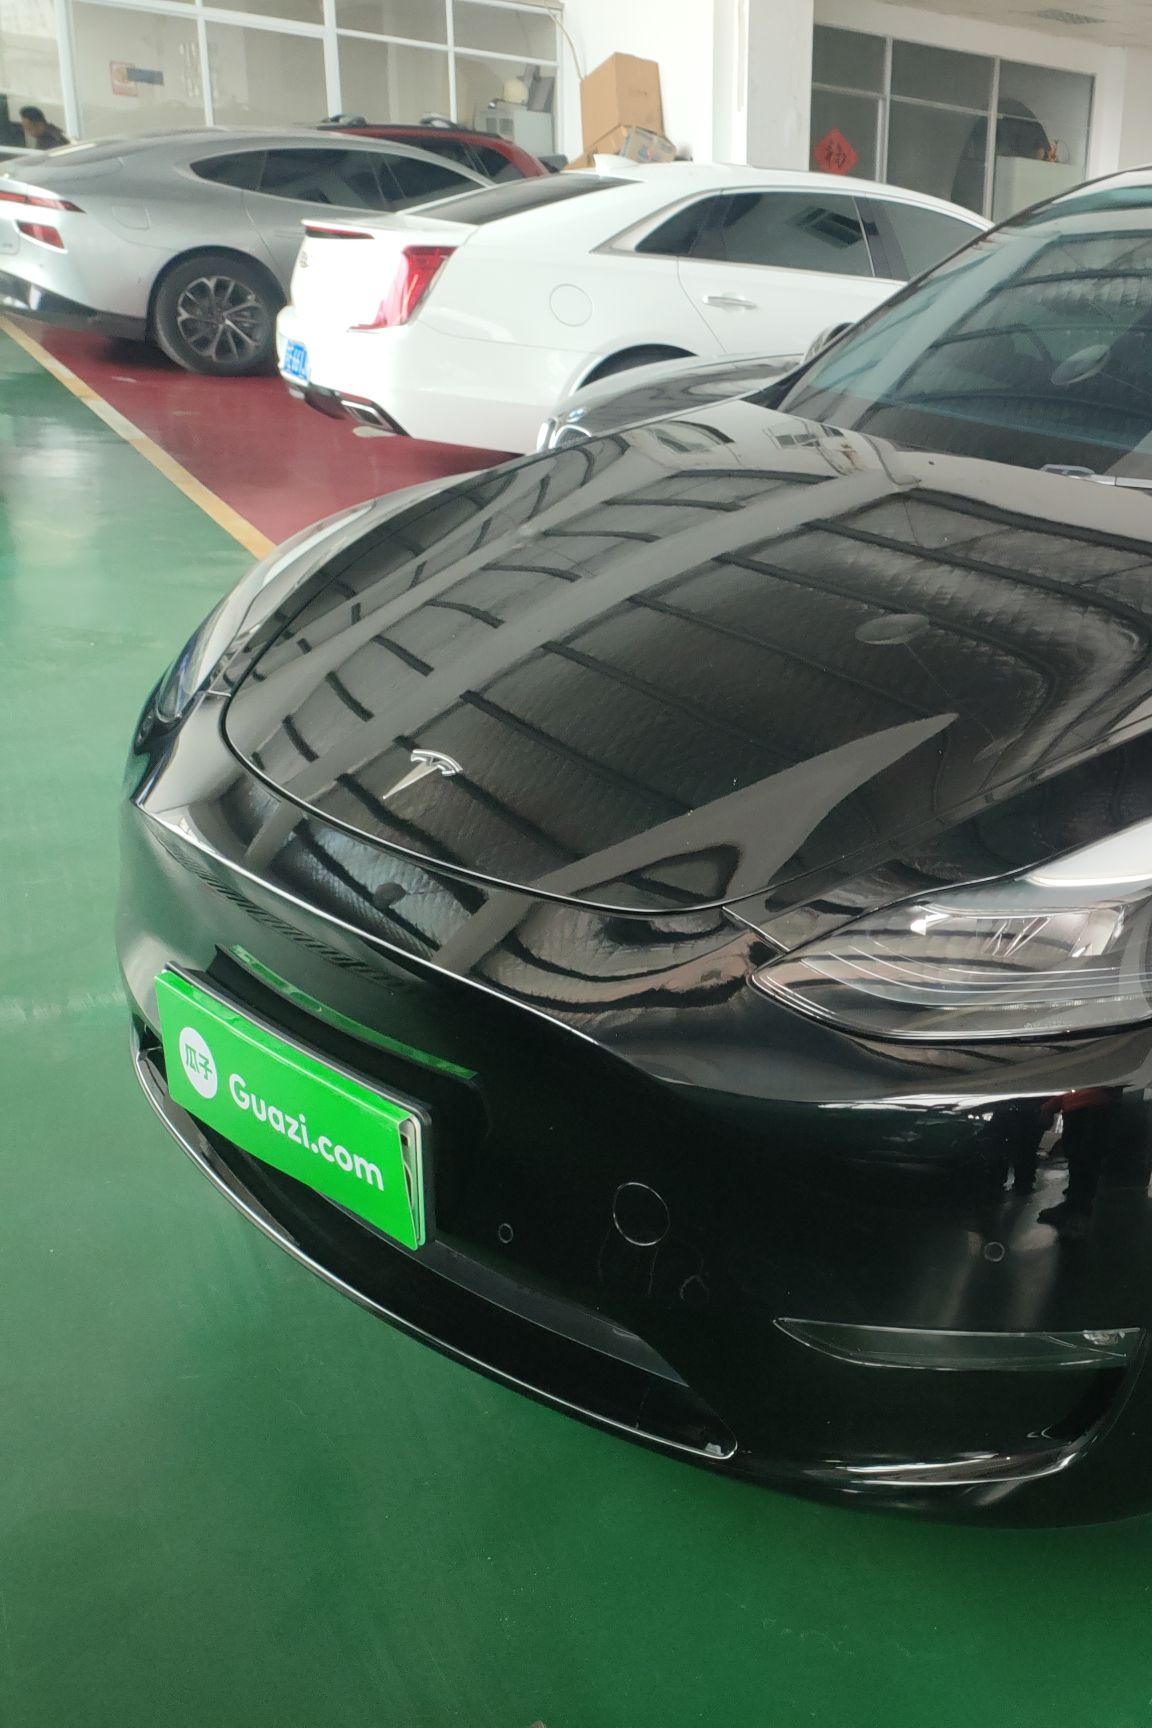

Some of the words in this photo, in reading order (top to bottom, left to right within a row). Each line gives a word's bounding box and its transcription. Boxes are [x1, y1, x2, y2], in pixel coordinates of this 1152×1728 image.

[824, 138, 848, 169] 福
[185, 1043, 213, 1080] 瓜子
[228, 1073, 385, 1191] Guazi.com
